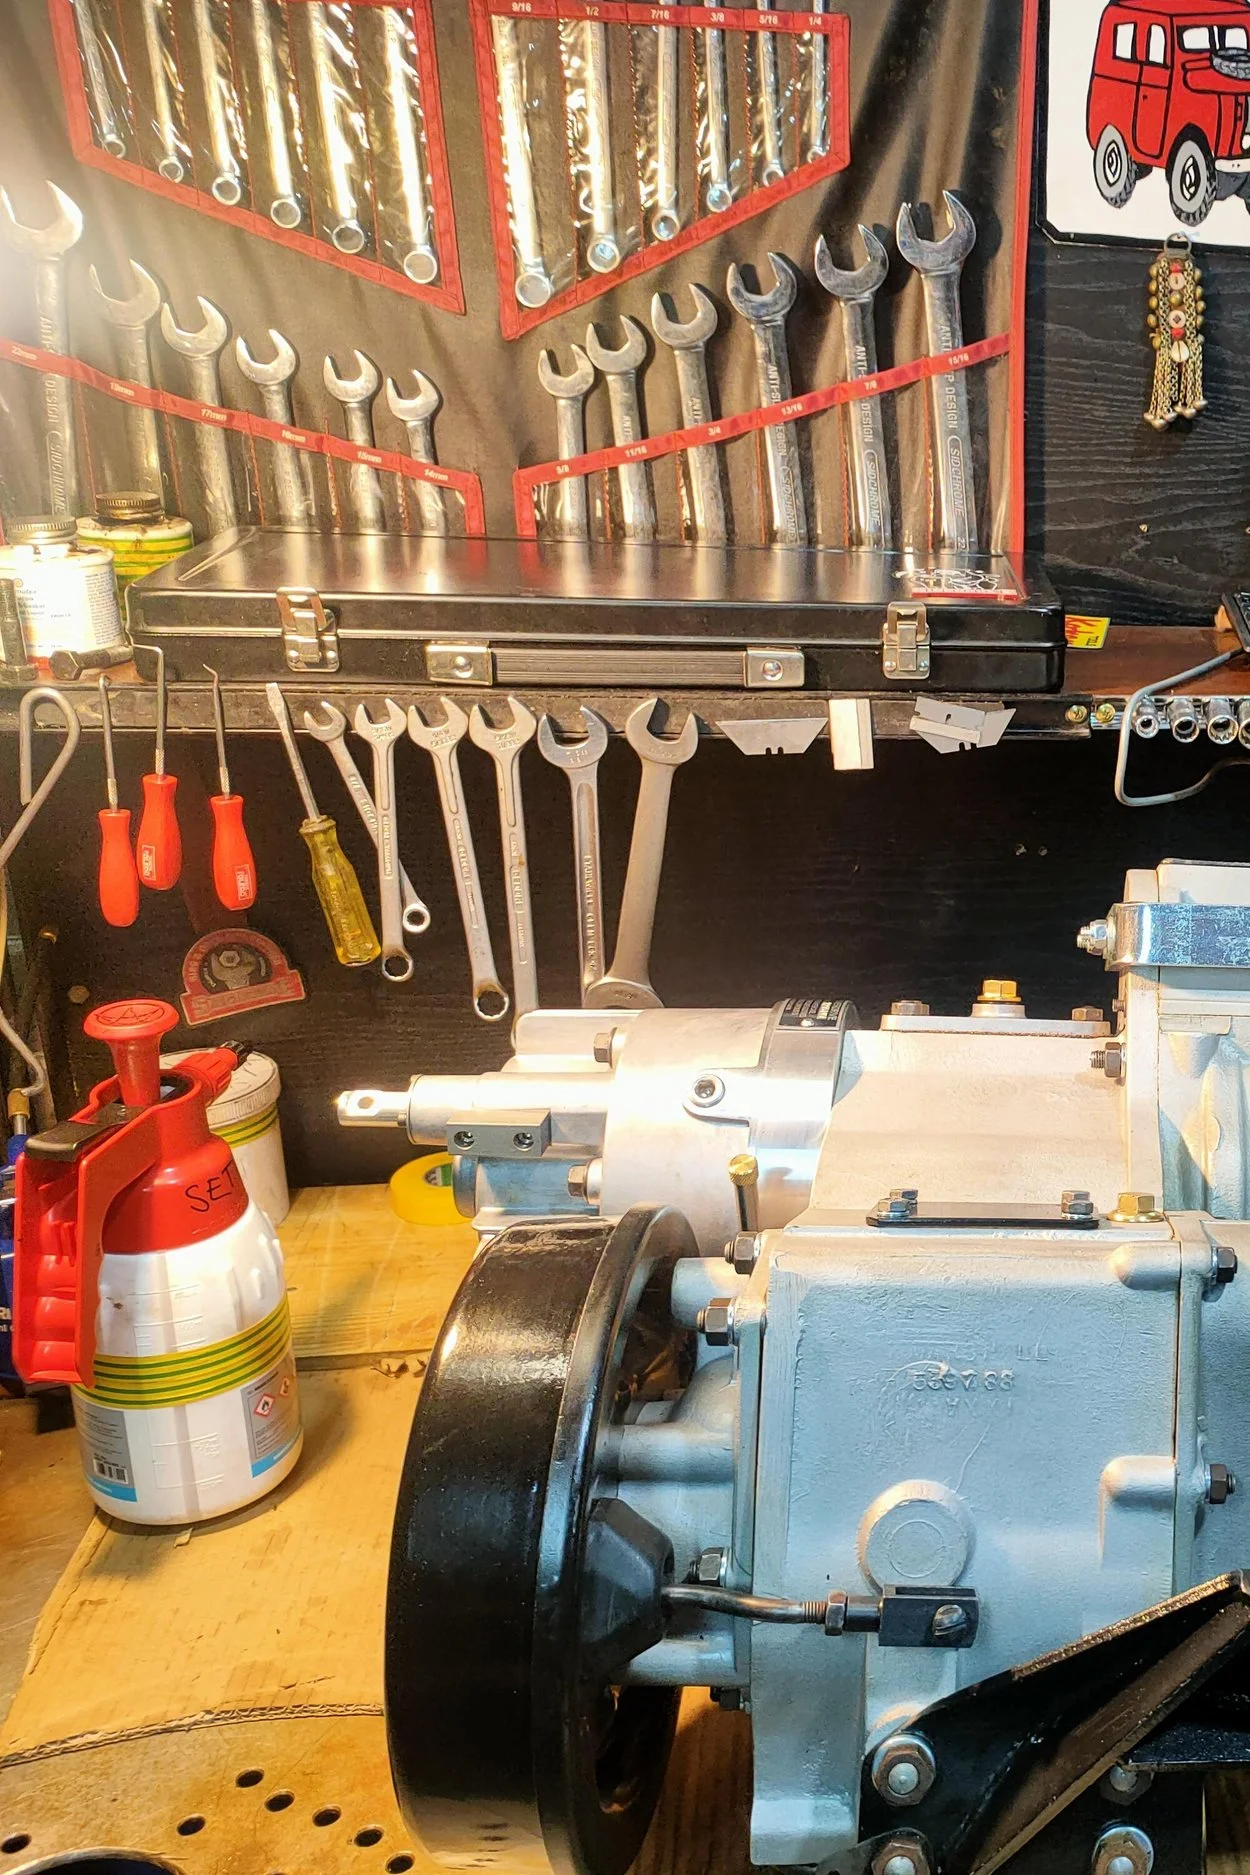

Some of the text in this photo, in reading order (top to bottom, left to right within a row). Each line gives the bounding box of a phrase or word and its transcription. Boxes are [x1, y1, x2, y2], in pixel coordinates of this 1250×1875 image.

[511, 3, 532, 13] 9/16
[585, 6, 600, 17] 1/2
[650, 9, 670, 19] 7/16
[710, 12, 725, 22] 3/8
[759, 14, 778, 25] 5/16
[809, 16, 822, 26] 1/4
[947, 353, 970, 366] 15/16
[201, 408, 228, 421] 17mm
[781, 403, 803, 417] 13/16
[944, 389, 958, 430] DESIGN
[860, 403, 874, 443] DESIGN
[707, 425, 722, 437] 3/4
[624, 445, 648, 458] 11/16
[424, 468, 449, 482] 14mm
[949, 447, 966, 520] SIDCHROME
[865, 459, 881, 527] SIDCHROME
[184, 1157, 235, 1213] SET
